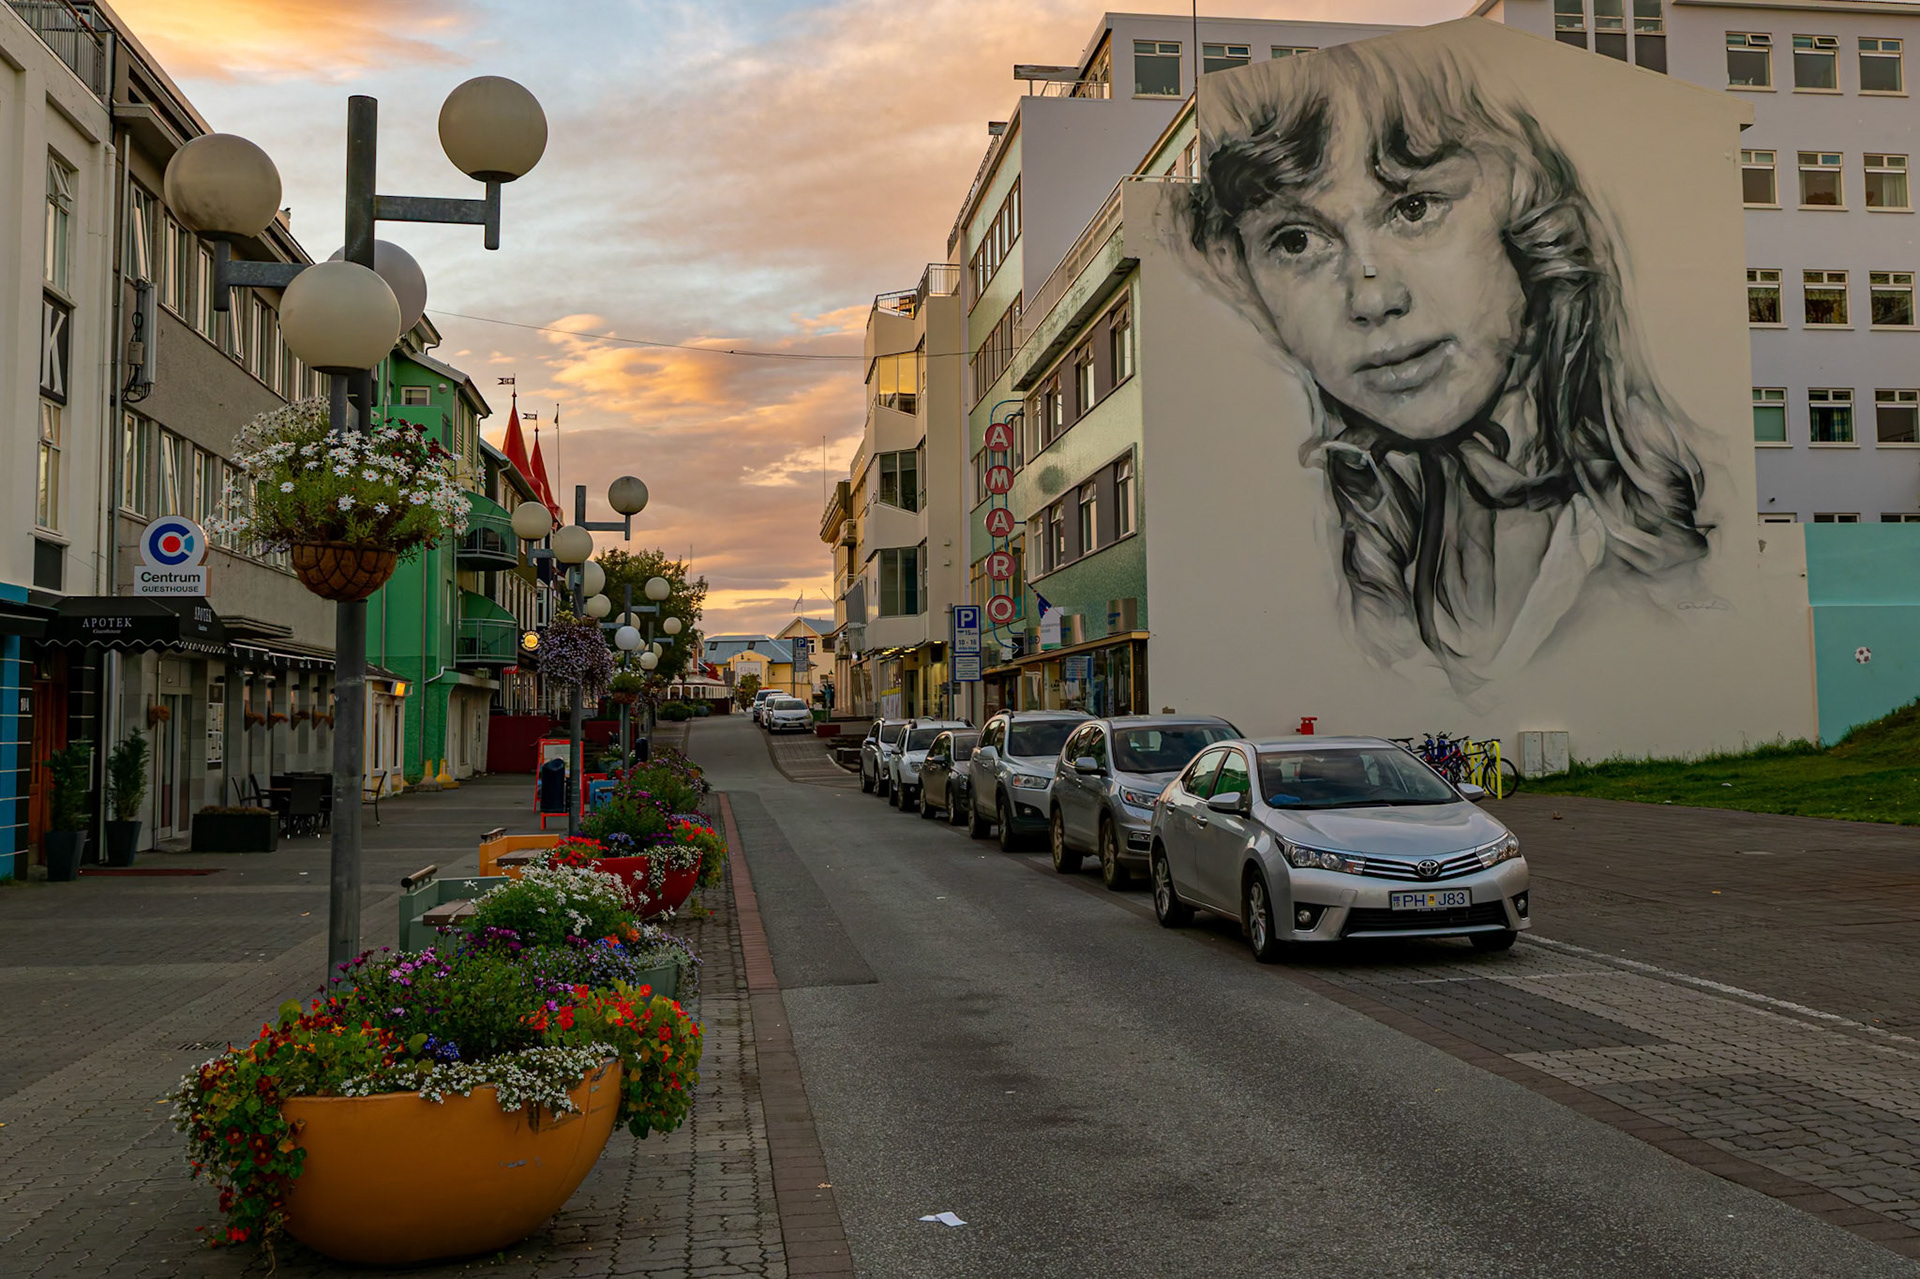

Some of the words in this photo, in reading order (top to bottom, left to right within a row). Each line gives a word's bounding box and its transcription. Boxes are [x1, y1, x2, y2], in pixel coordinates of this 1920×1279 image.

[988, 425, 1013, 620] AMARO
[141, 571, 201, 583] Centrum
[82, 617, 132, 628] APOTEK
[1403, 894, 1425, 907] PH
[1438, 892, 1466, 906] J83
